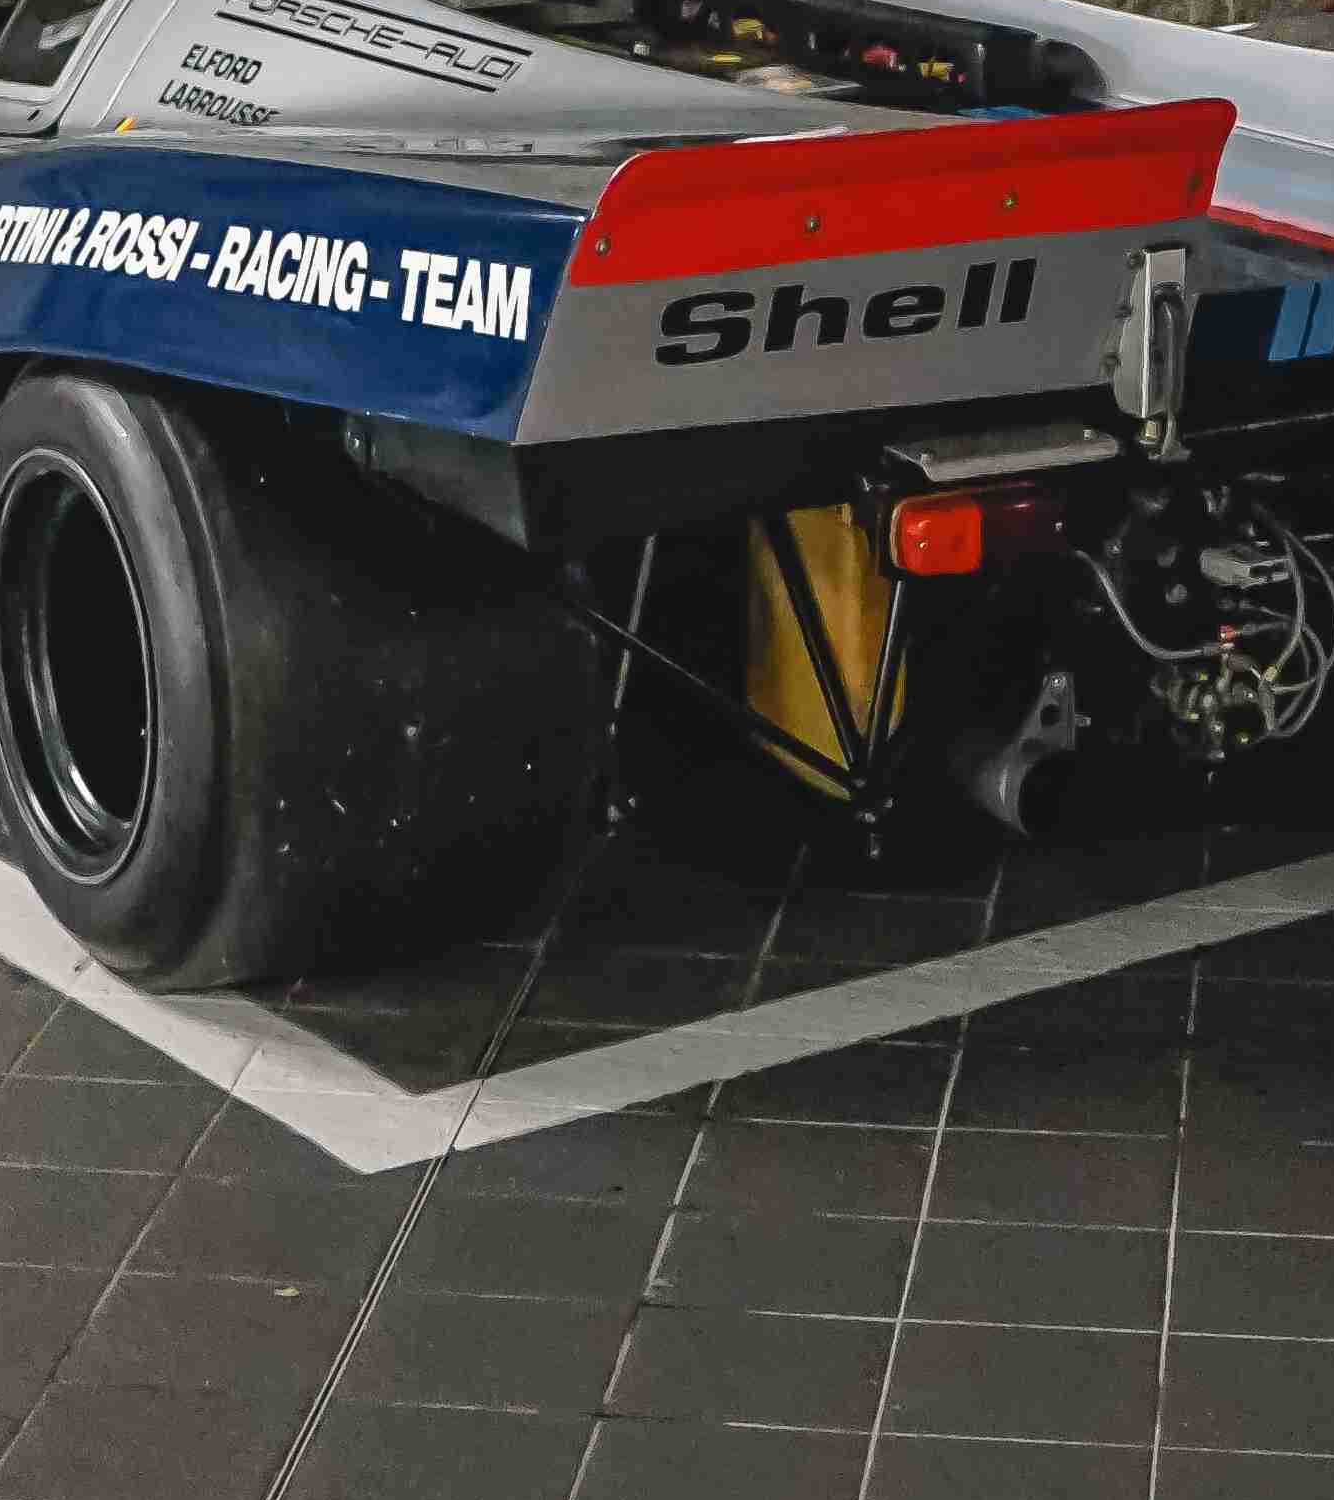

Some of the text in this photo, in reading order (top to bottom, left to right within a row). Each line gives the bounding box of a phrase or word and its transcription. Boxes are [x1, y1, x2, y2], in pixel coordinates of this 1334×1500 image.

[180, 43, 263, 85] ELFORD
[51, 207, 90, 265] &
[75, 210, 200, 281] ROSSI
[207, 225, 367, 312] RACING
[400, 249, 531, 341] TEAM
[654, 257, 1037, 366] Shell
